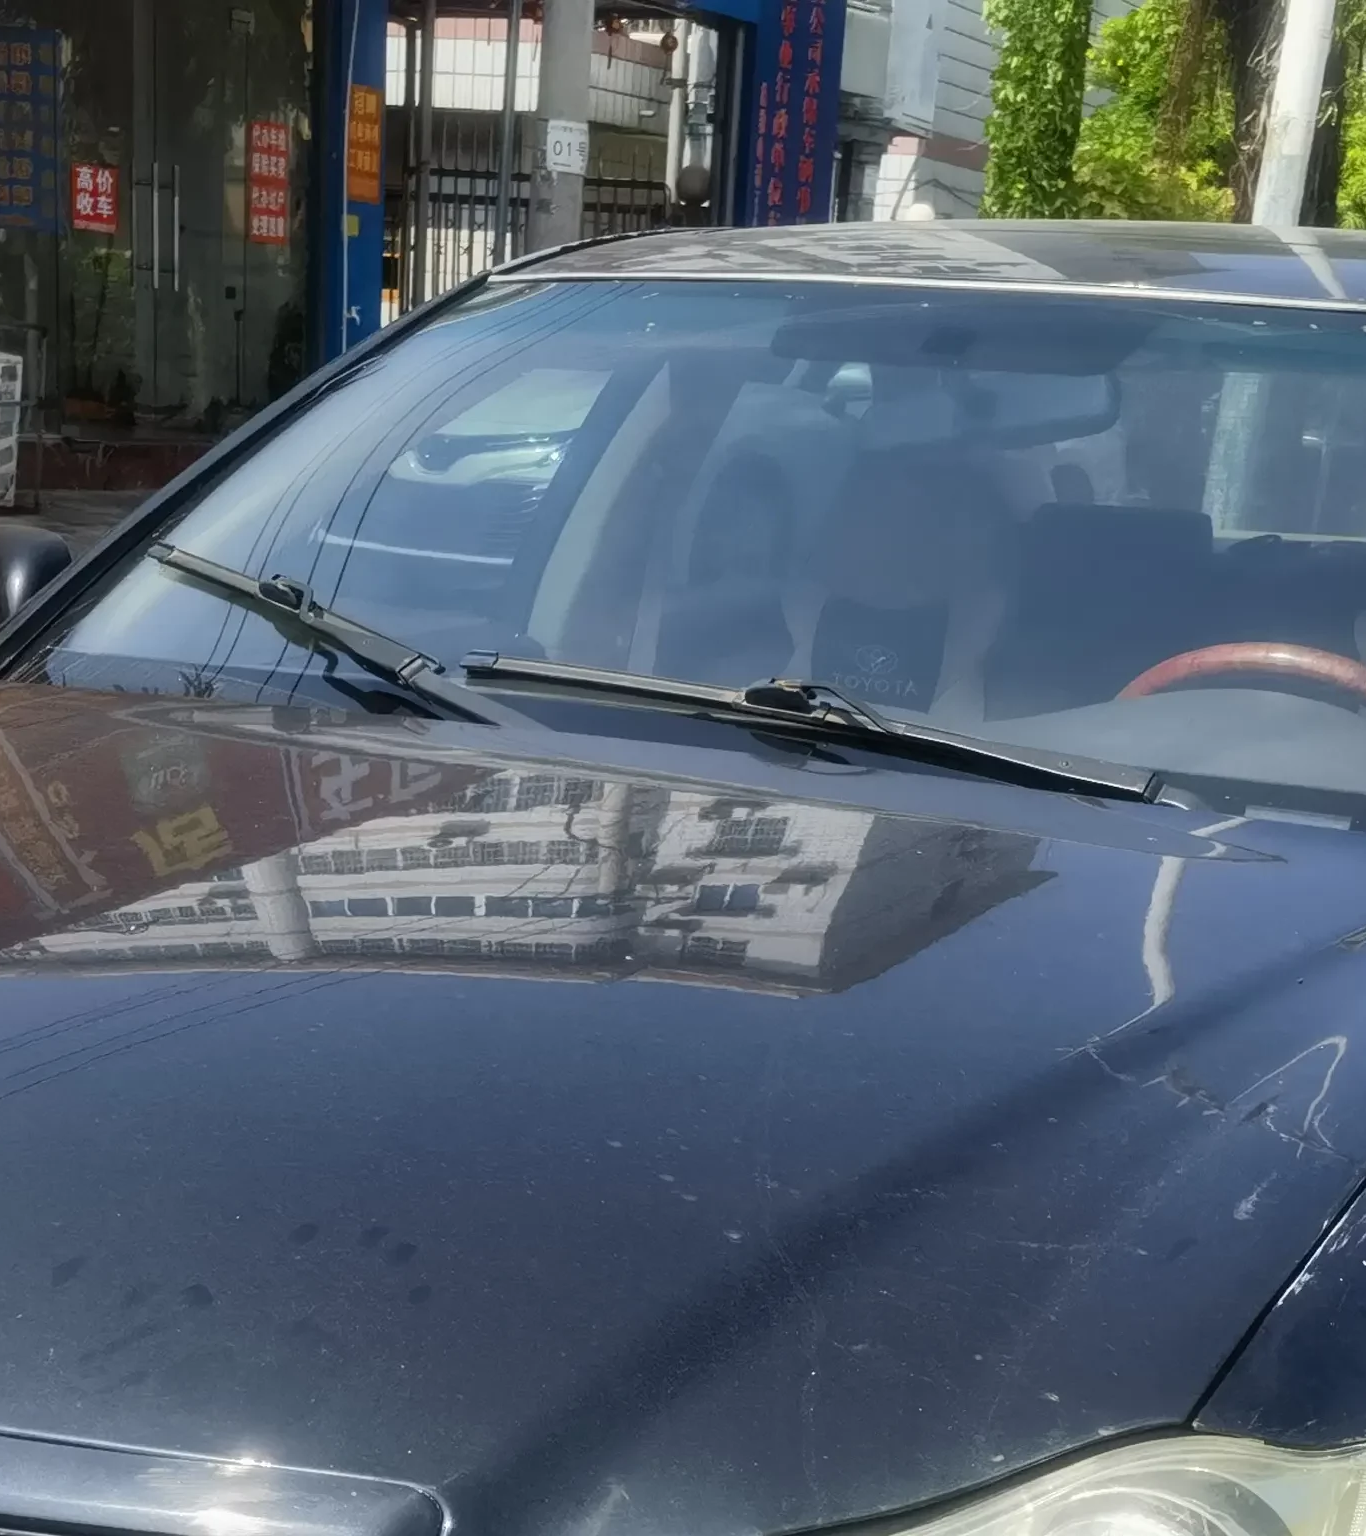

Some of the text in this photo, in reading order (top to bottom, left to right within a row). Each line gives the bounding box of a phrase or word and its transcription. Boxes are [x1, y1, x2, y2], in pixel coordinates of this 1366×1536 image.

[76, 166, 113, 193] 高价
[76, 192, 114, 218] 收车
[833, 672, 918, 697] TOYOTA
